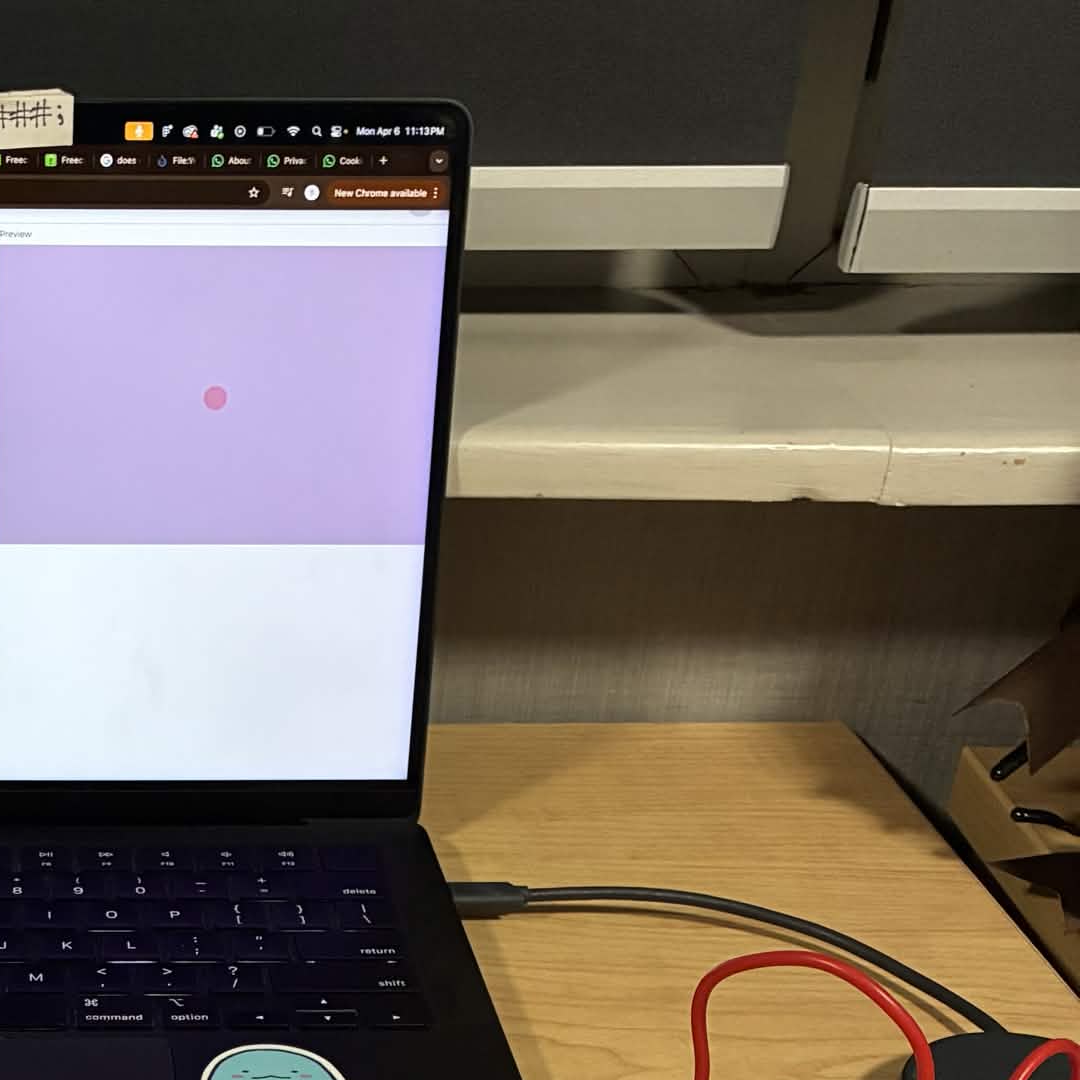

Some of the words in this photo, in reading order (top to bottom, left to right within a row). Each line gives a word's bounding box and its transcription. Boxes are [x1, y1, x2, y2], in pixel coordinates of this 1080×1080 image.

[356, 127, 377, 135] Mon
[376, 127, 395, 137] Apr
[394, 126, 400, 136] 6
[117, 156, 136, 164] does
[334, 189, 354, 197] New
[355, 189, 388, 197] Chrome
[390, 189, 427, 197] available
[0, 230, 32, 238] Preview
[62, 941, 72, 949] K
[127, 941, 136, 949] L
[29, 973, 43, 982] M
